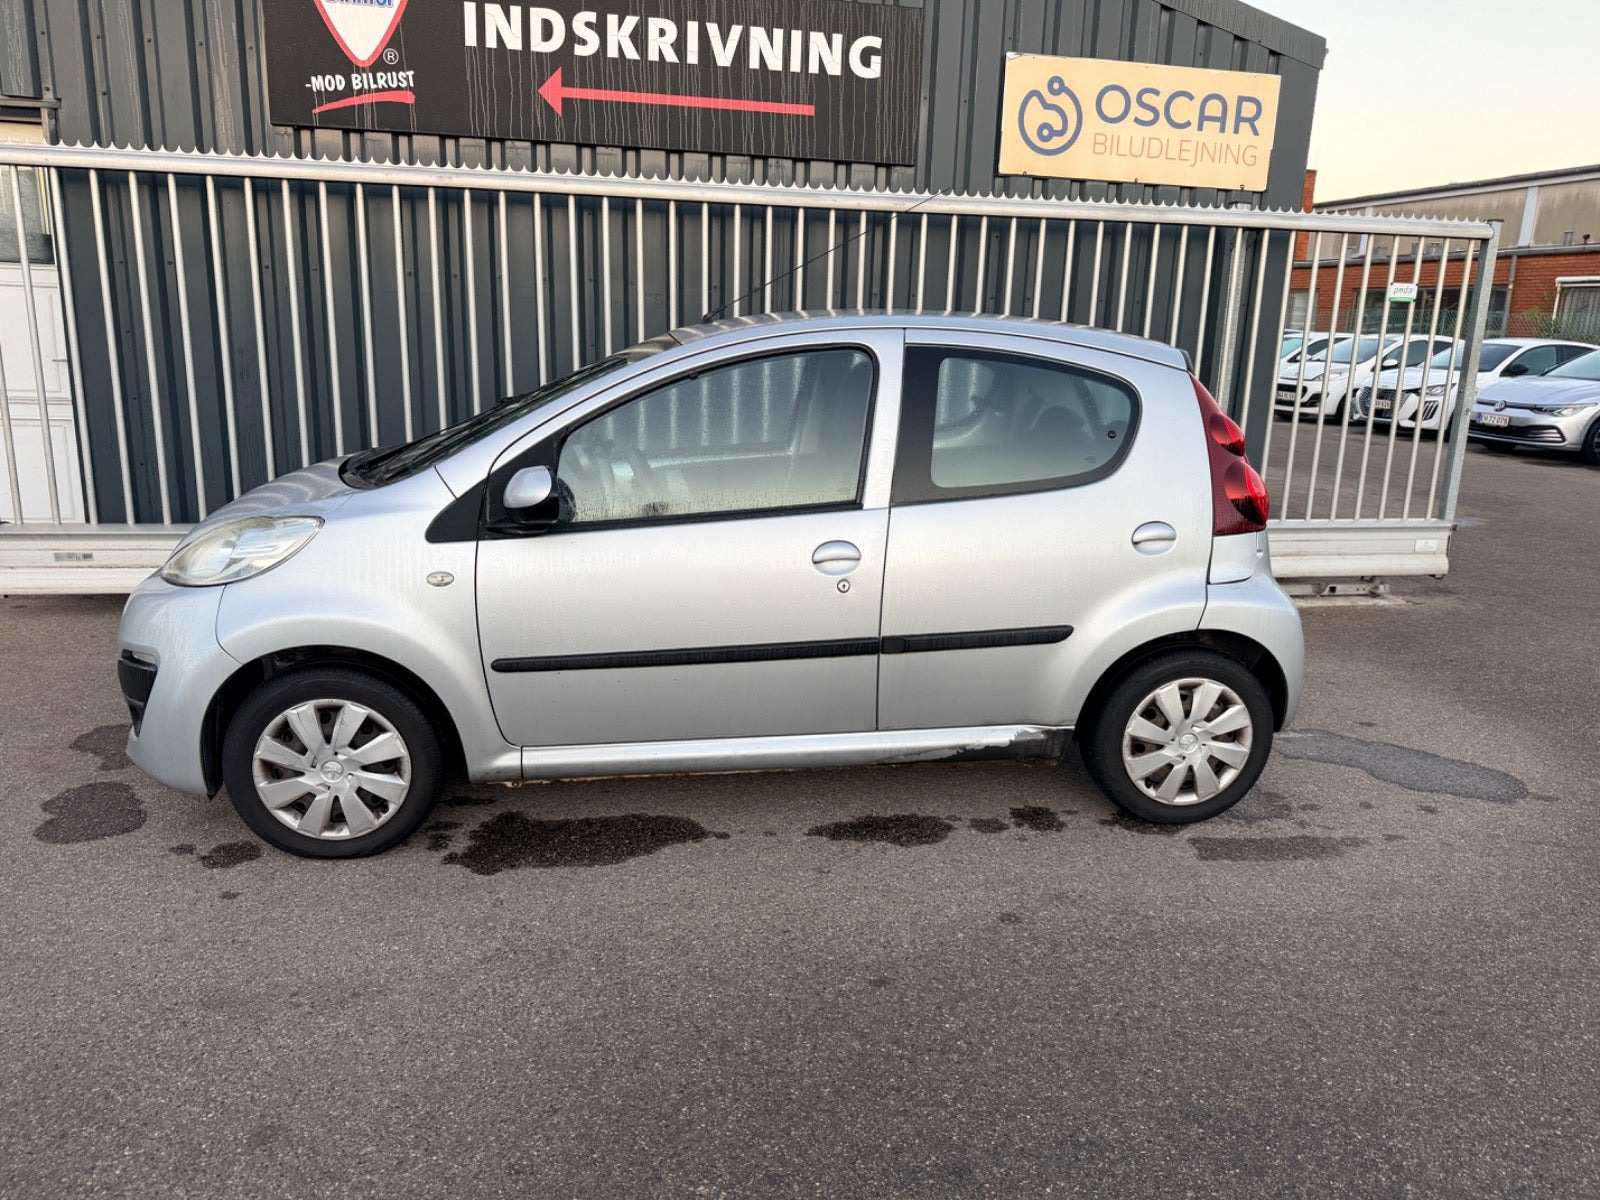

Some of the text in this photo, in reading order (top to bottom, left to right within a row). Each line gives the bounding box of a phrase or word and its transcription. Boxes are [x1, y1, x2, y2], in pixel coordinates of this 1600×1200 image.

[463, 1, 883, 79] INDSKRIVNING
[351, 70, 415, 91] BILRUST
[1095, 84, 1263, 136] OSCAR
[1092, 132, 1258, 167] BILUDLEJNING
